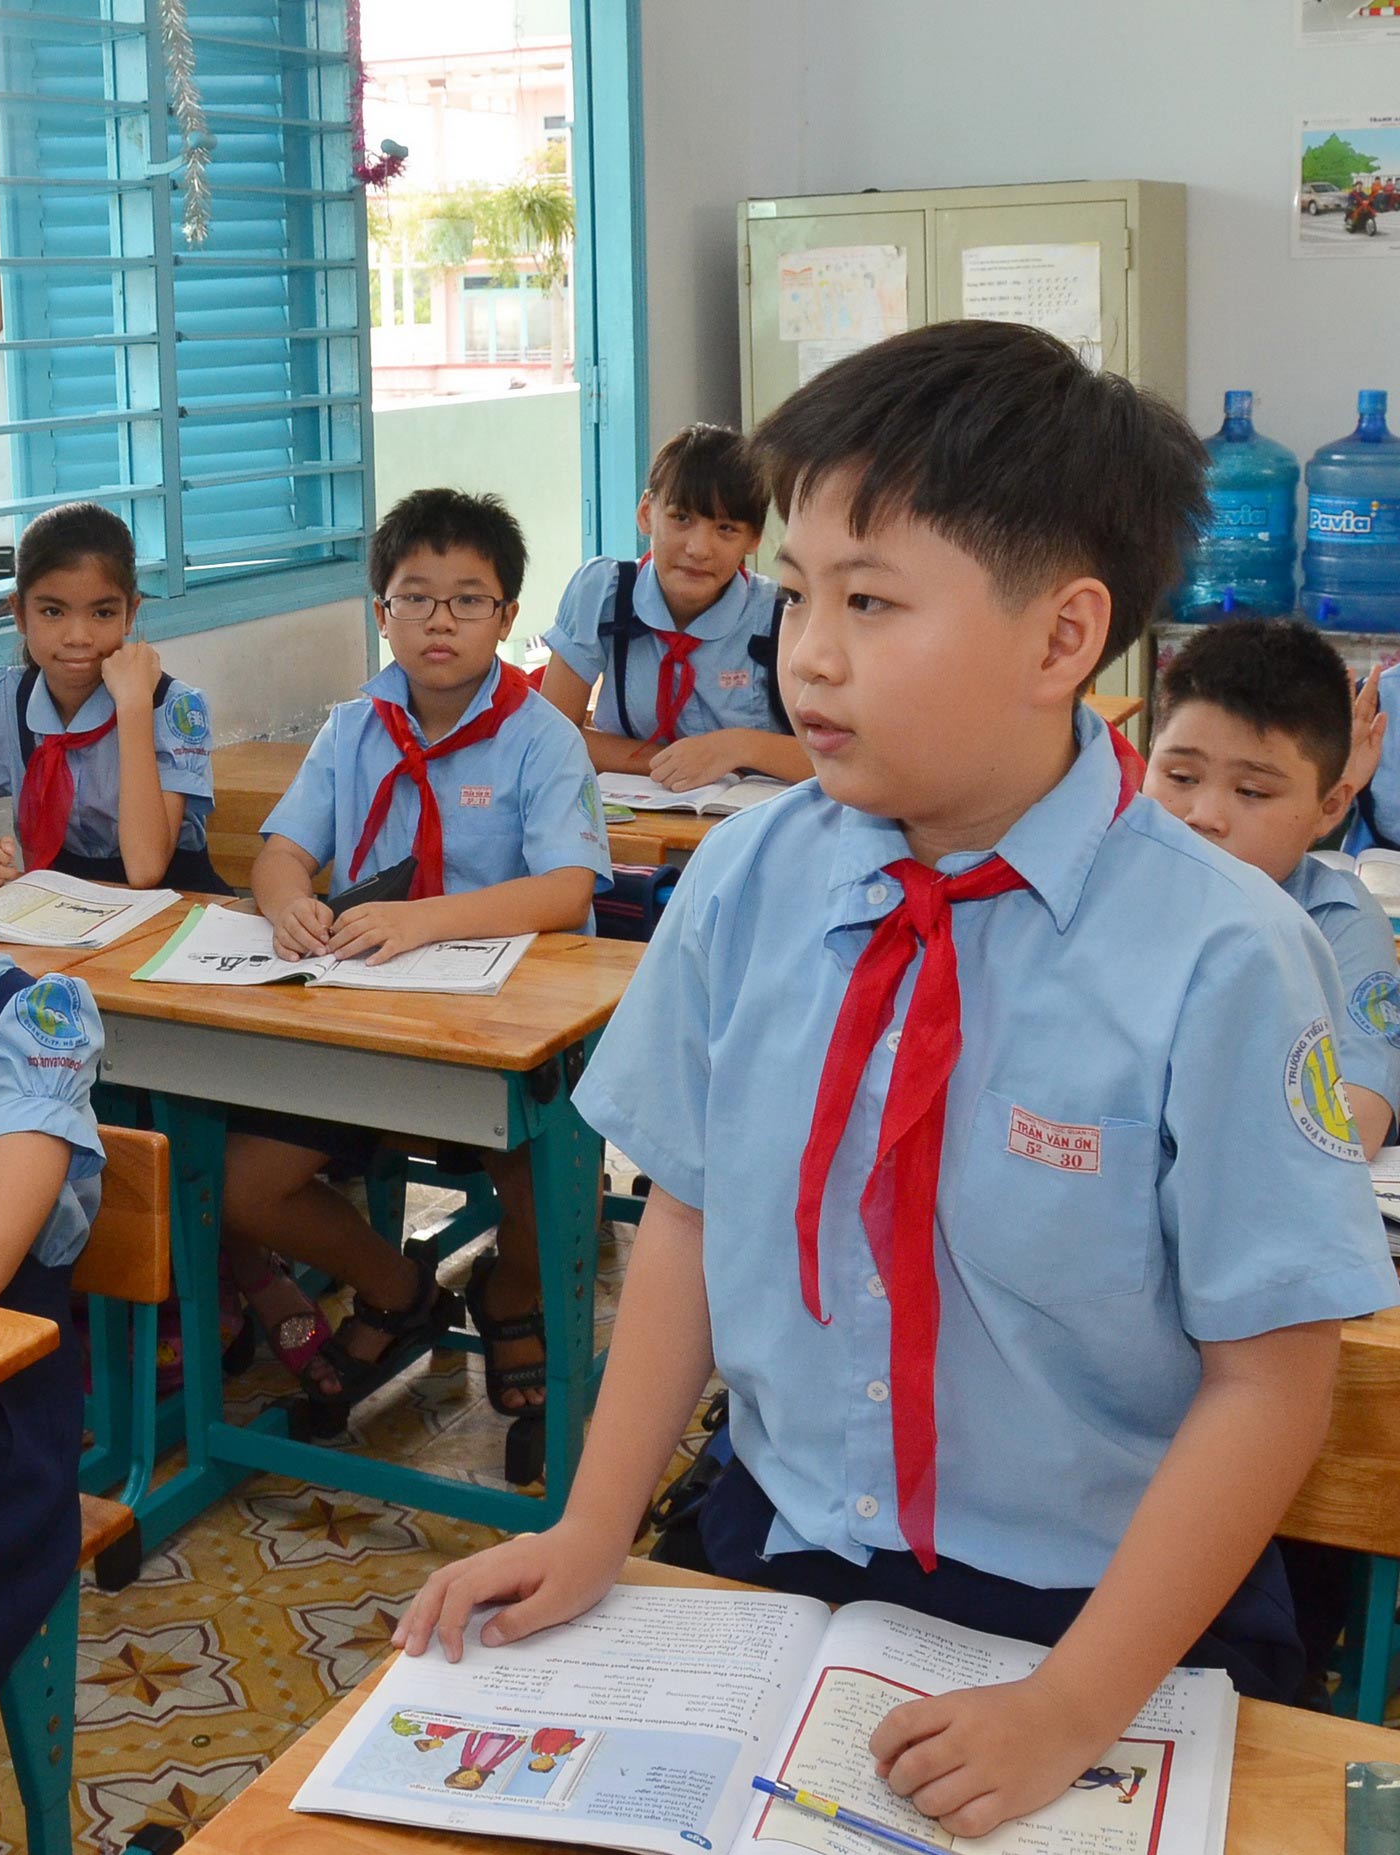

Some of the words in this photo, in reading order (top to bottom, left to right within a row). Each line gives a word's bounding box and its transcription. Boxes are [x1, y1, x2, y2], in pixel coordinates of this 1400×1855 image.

[1310, 509, 1371, 533] Pavia
[1288, 1040, 1308, 1086] TRƯỜNG
[1304, 1018, 1324, 1041] TIỂU
[1017, 1120, 1043, 1140] TRẦN
[1046, 1132, 1070, 1148] VĂN
[1300, 1116, 1328, 1146] QUẬN
[1060, 1153, 1083, 1168] 30
